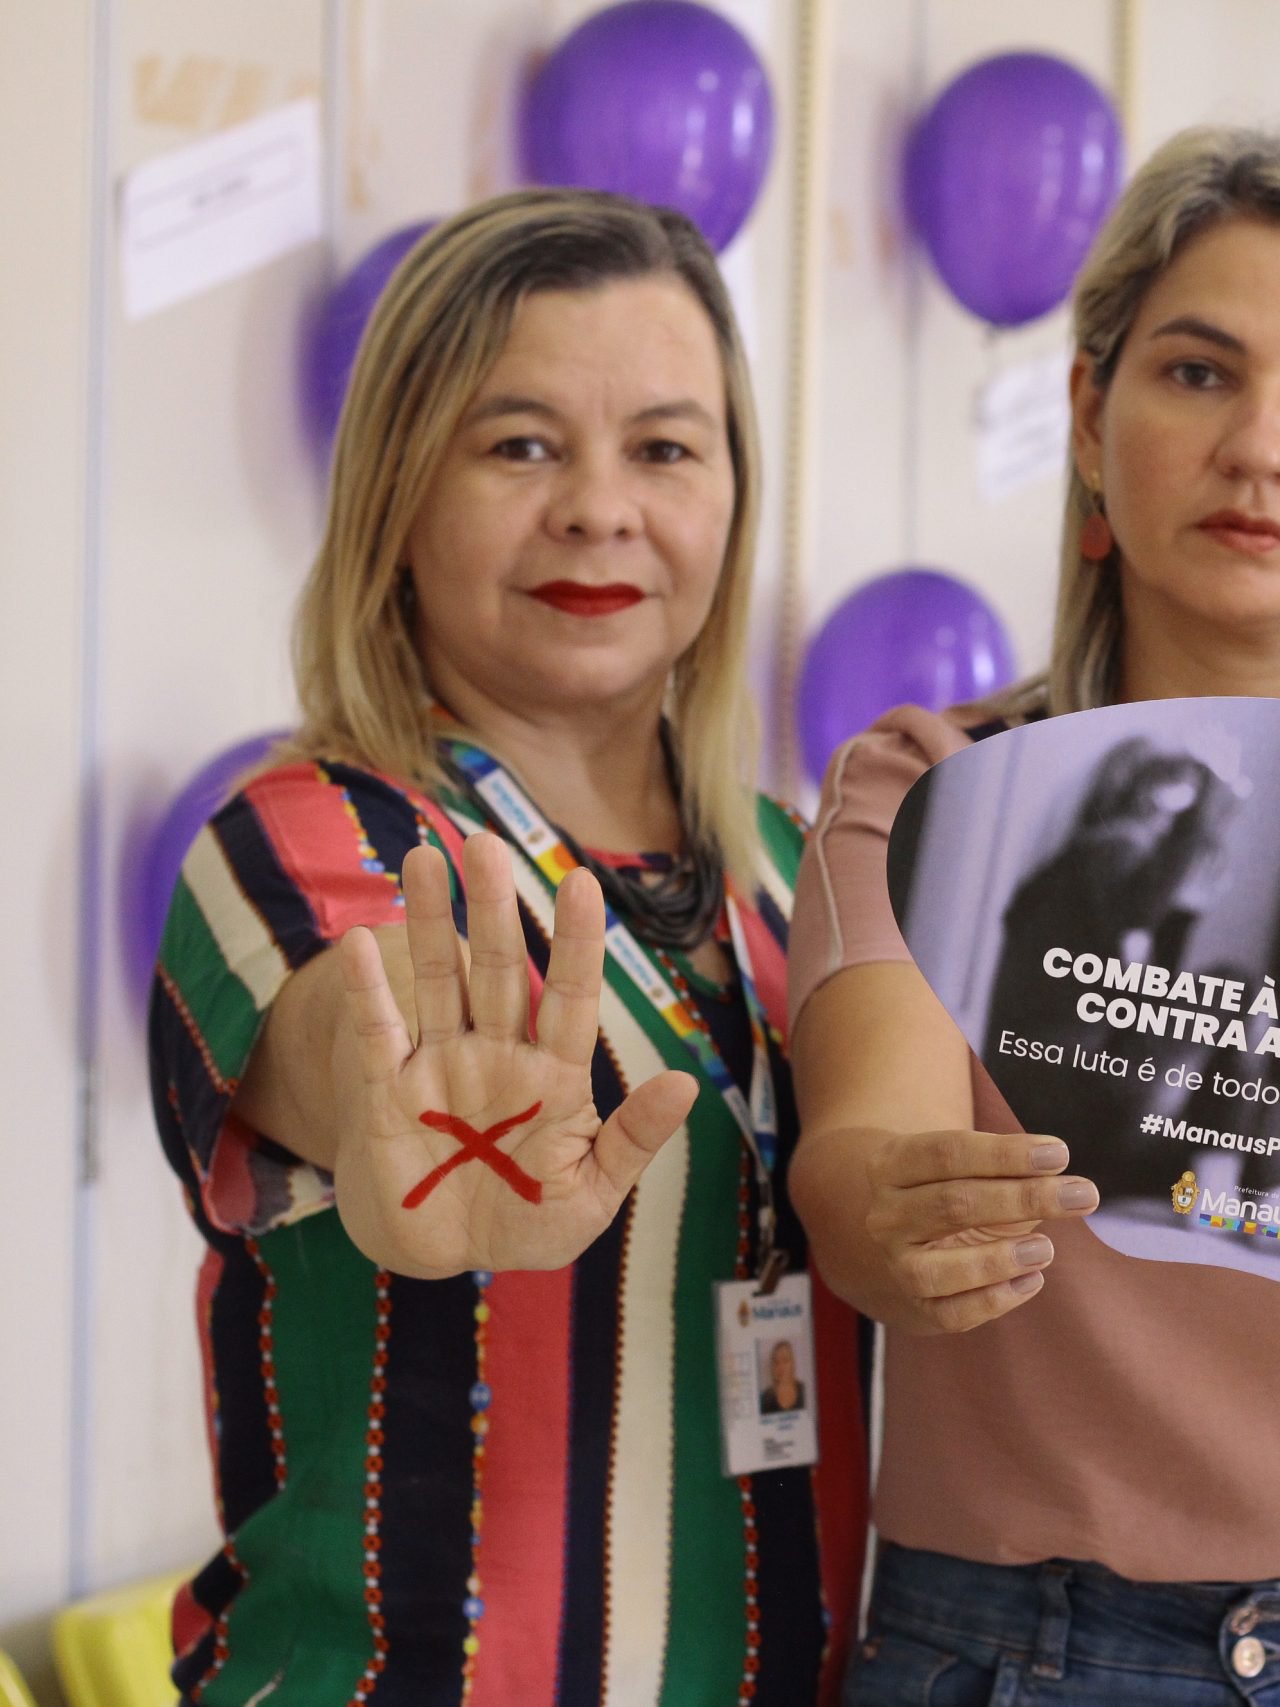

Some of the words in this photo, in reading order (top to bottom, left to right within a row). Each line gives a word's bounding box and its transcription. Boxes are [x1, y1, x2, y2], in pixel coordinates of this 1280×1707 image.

[1042, 947, 1246, 1013] COMBATE
[1247, 974, 1279, 1020] À
[1076, 992, 1248, 1052] CONTRA
[998, 1029, 1065, 1065] Essa
[1072, 1043, 1129, 1078] luta
[1137, 1056, 1156, 1082] é
[1164, 1063, 1203, 1091] de
[1233, 1185, 1269, 1198] Prefeitura
